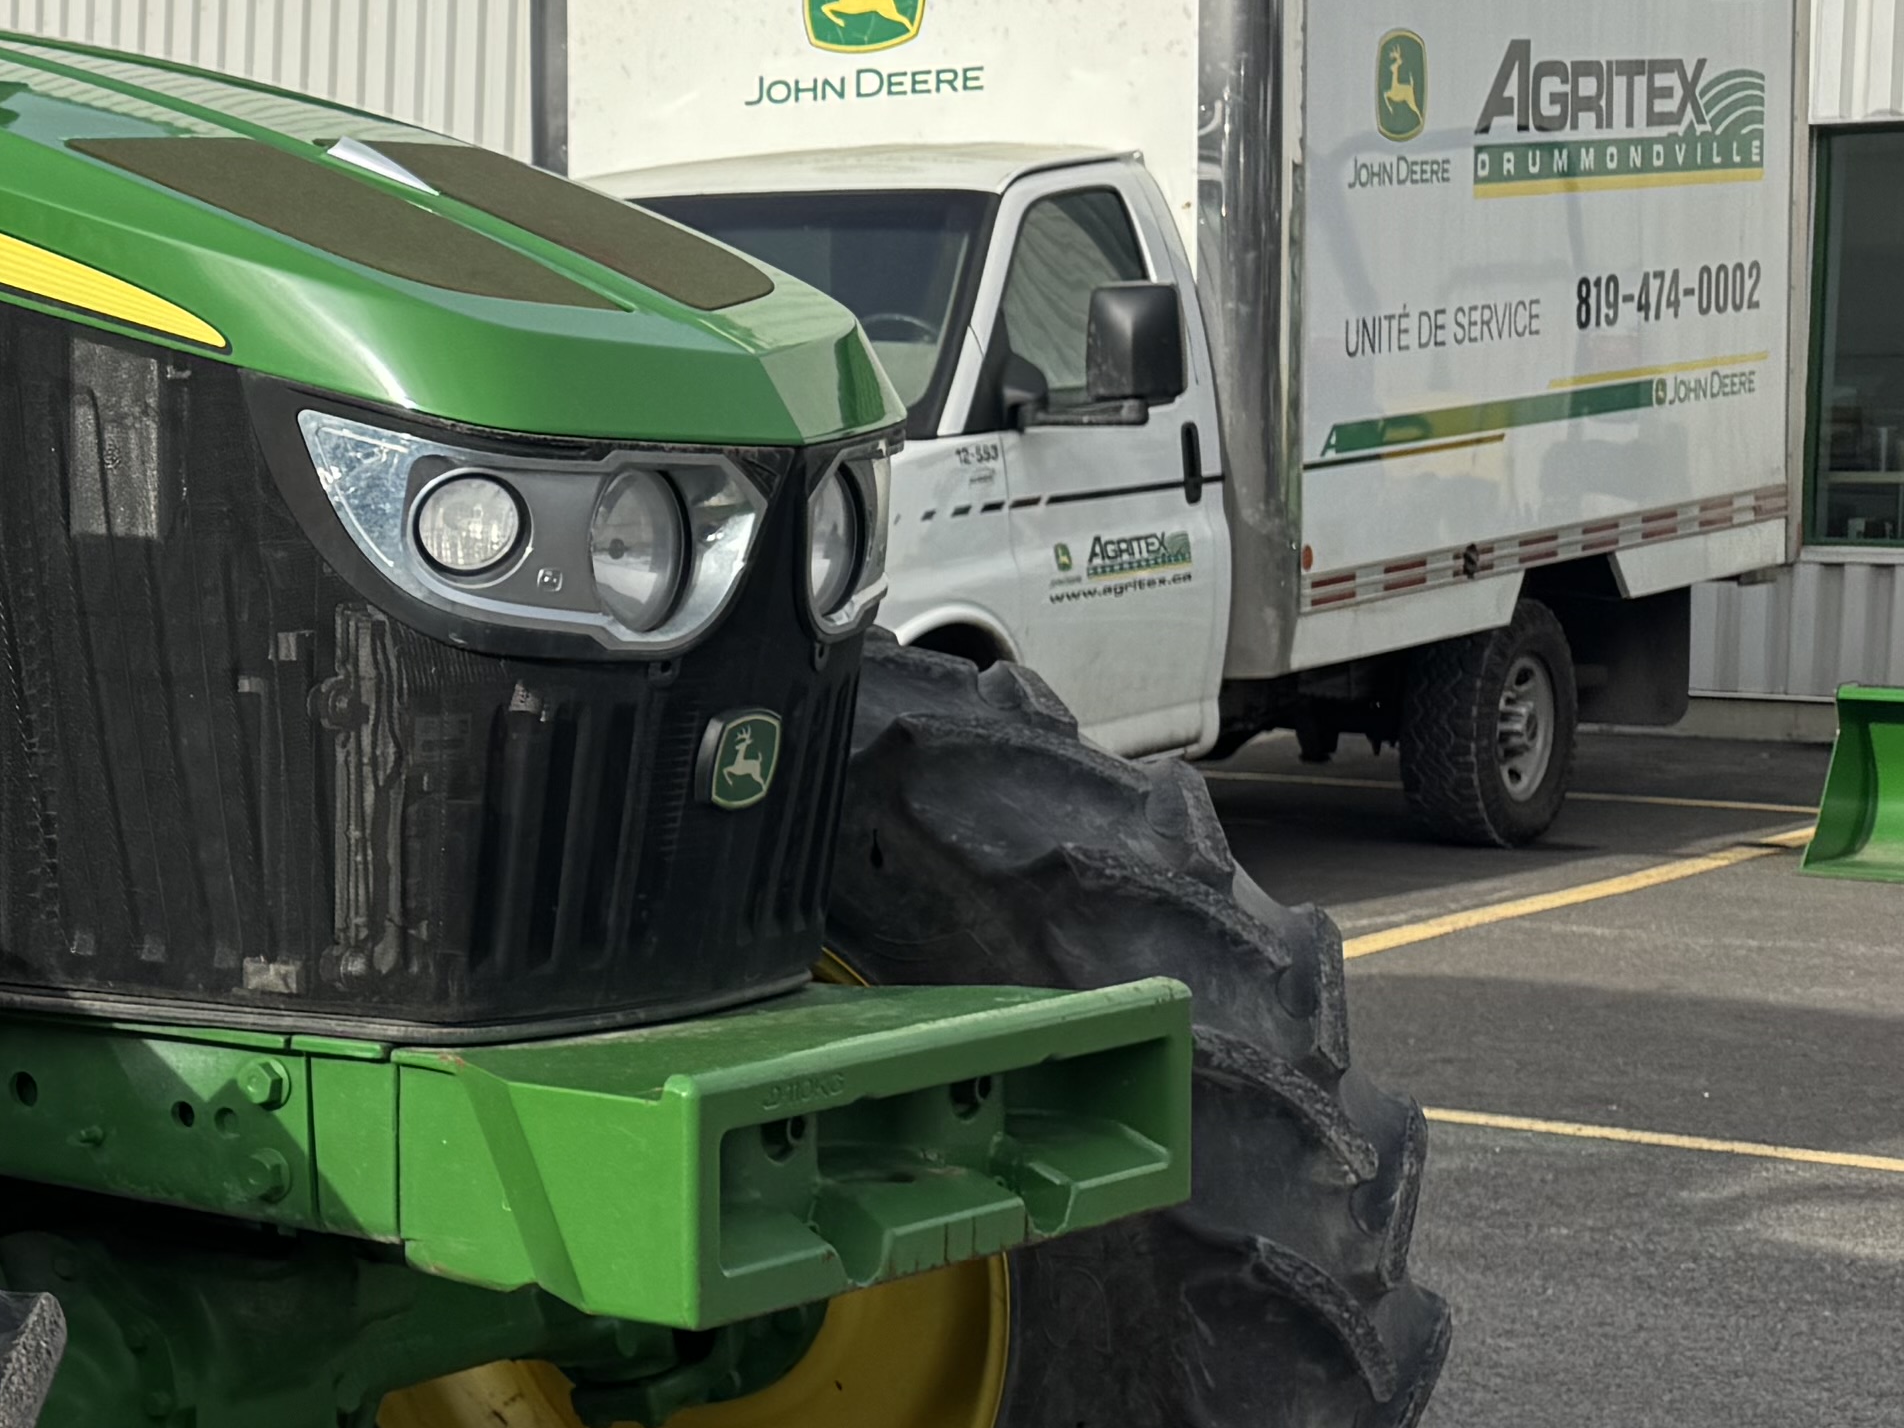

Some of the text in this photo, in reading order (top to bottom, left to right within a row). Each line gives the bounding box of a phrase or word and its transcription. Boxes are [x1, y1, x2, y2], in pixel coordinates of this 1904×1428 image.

[744, 65, 985, 106] JOHN DEERE
[1474, 38, 1712, 135] AGRITEX
[1347, 155, 1451, 189] JOHN DEERE
[1476, 139, 1761, 178] DRUMMONDVILLE
[1575, 260, 1762, 331] 819-474-0002
[1344, 299, 1542, 358] UNITÉ DE SERVICE
[1668, 370, 1757, 407] JOHN DEERE
[1088, 531, 1169, 563] AGRITEX
